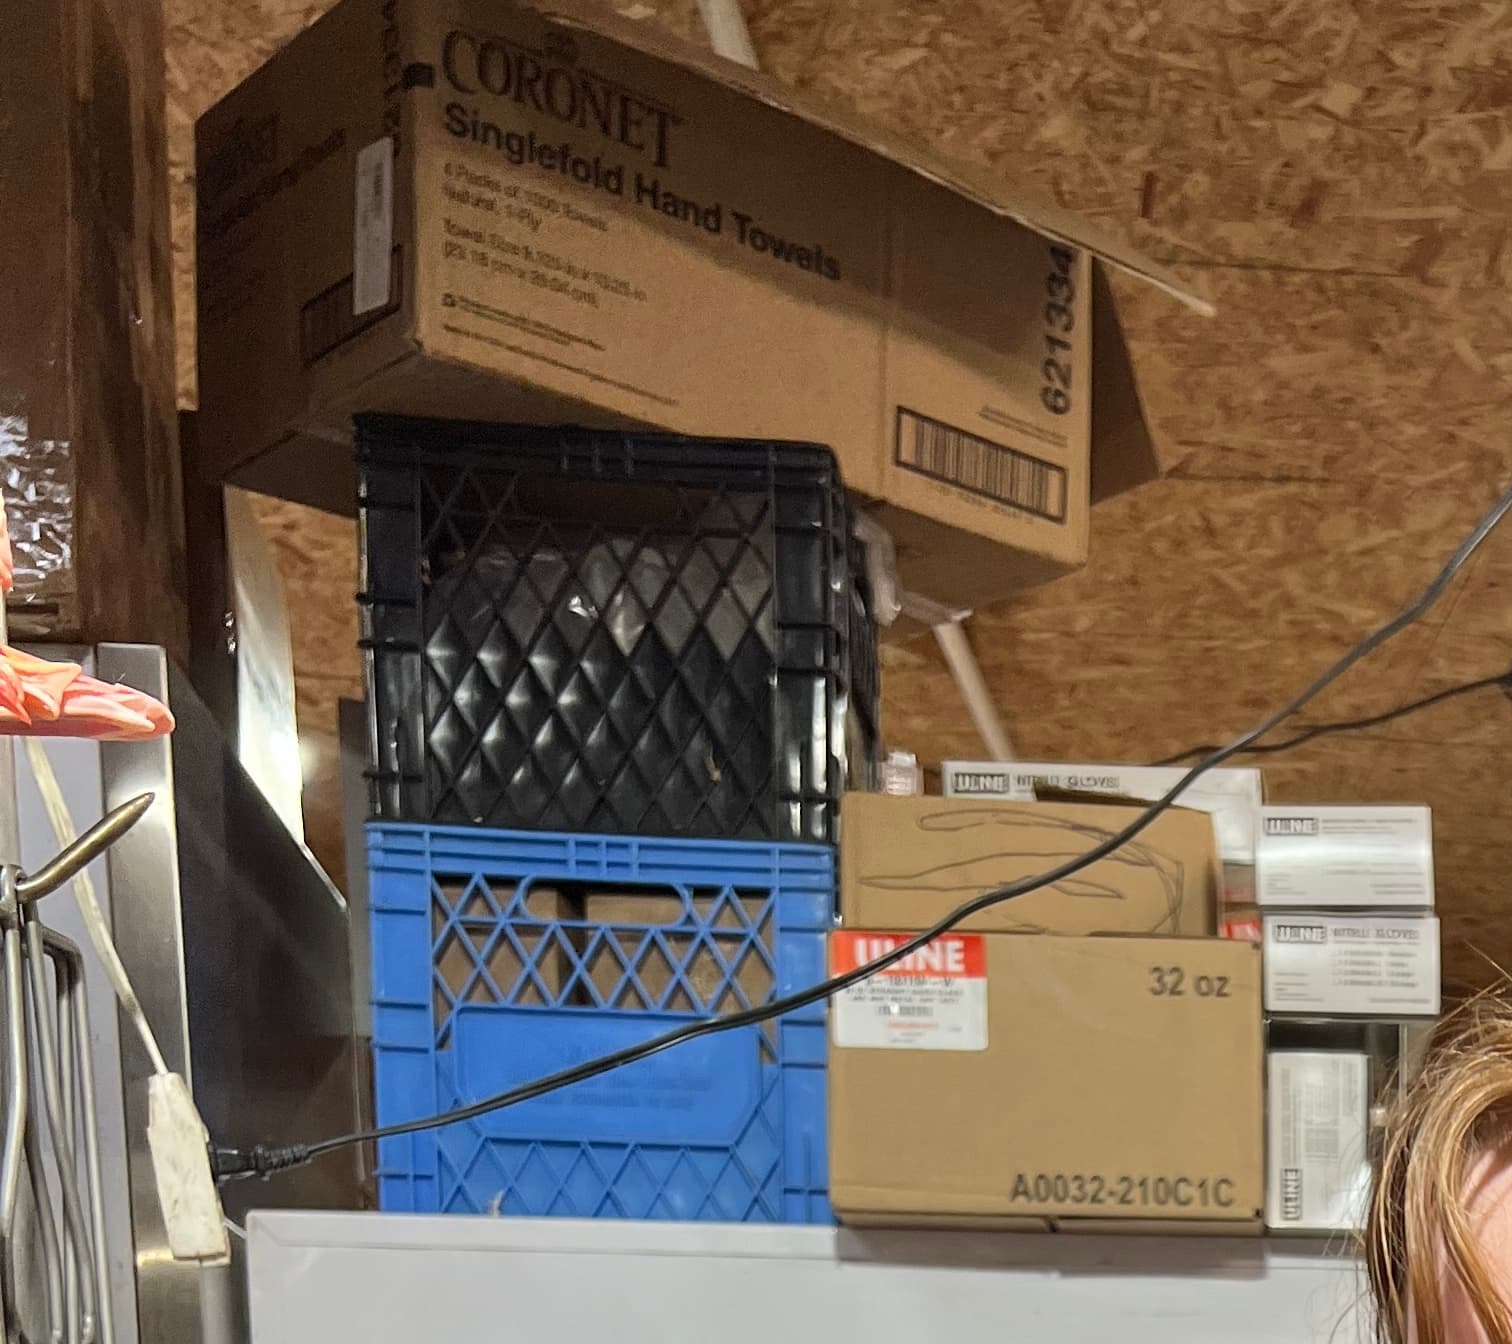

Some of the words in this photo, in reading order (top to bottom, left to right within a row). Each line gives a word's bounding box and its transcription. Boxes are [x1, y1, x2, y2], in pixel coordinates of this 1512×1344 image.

[443, 28, 684, 168] CORONET
[444, 101, 624, 196] Singlefold
[634, 171, 723, 234] Hand
[731, 210, 842, 281] Towels
[1041, 246, 1076, 415] 621334
[1149, 967, 1186, 996] 32
[1194, 971, 1231, 996] oz
[1010, 1173, 1236, 1208] A0032-210C1C
